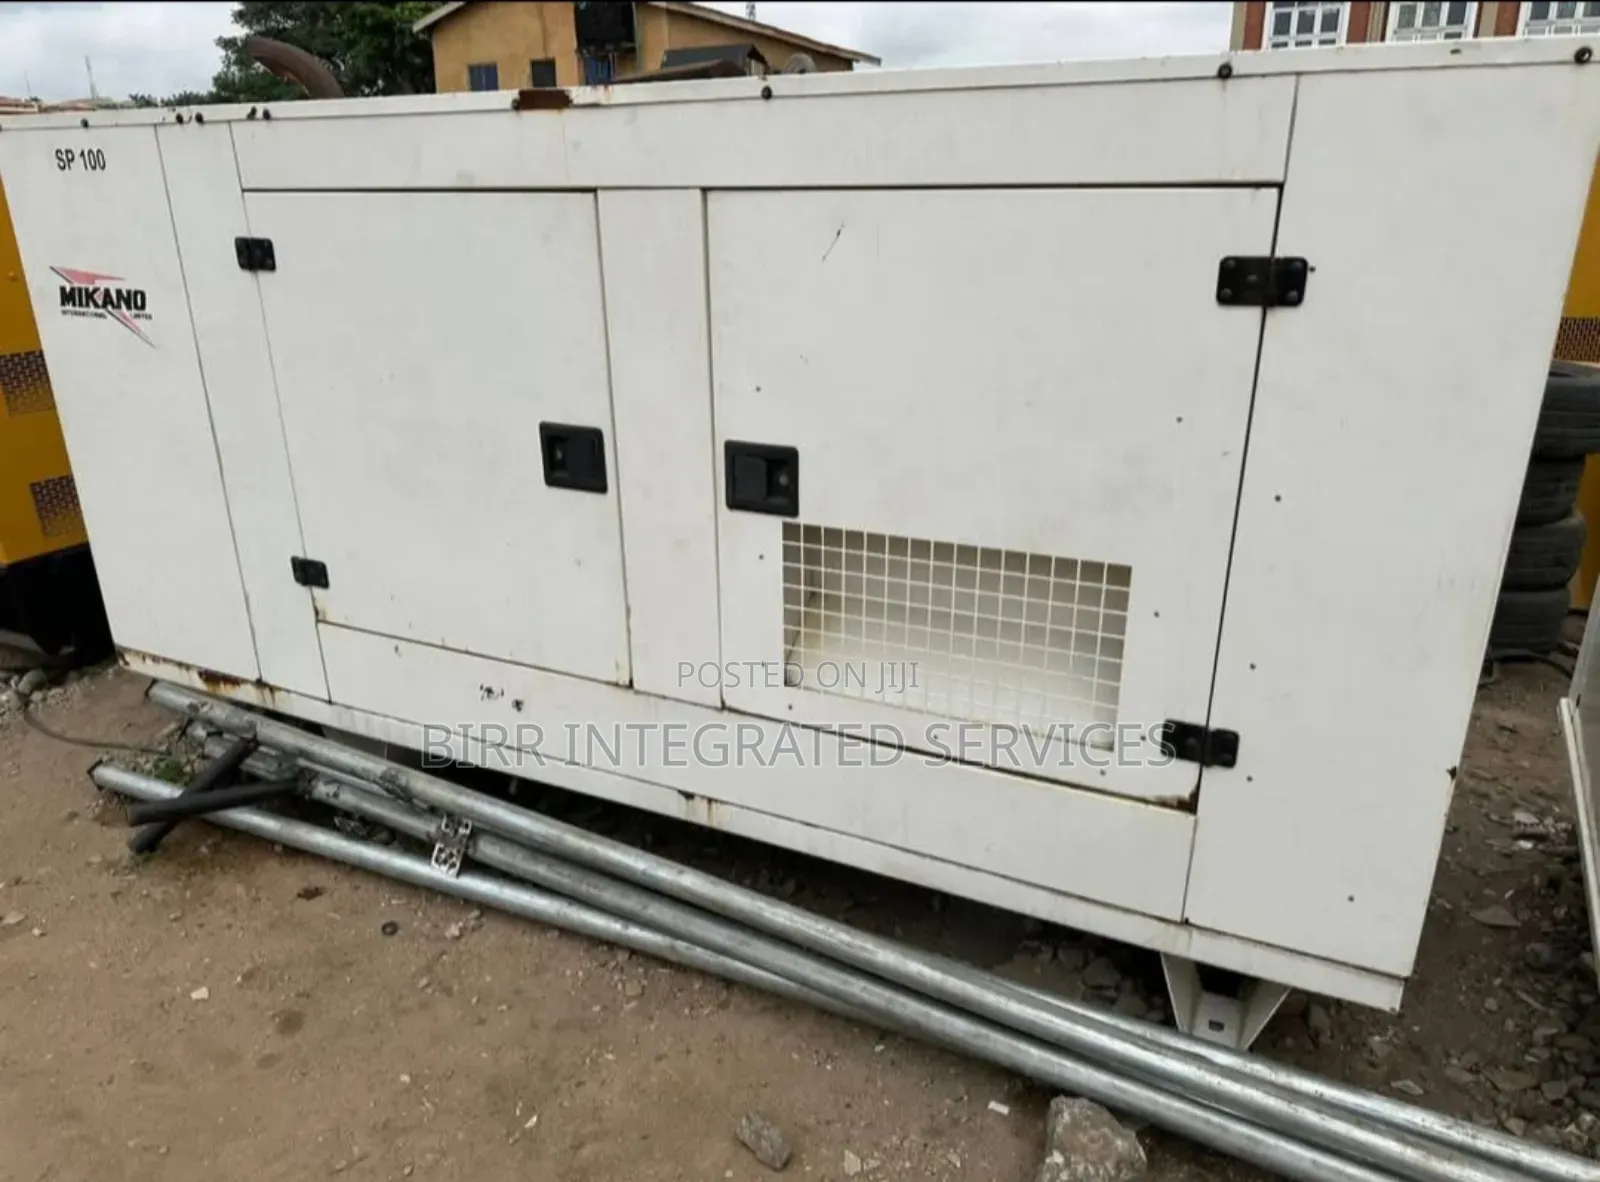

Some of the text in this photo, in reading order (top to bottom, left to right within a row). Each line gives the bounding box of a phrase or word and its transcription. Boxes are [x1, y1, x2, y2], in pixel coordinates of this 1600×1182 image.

[55, 147, 106, 171] SP 100
[59, 285, 147, 312] MIKANO
